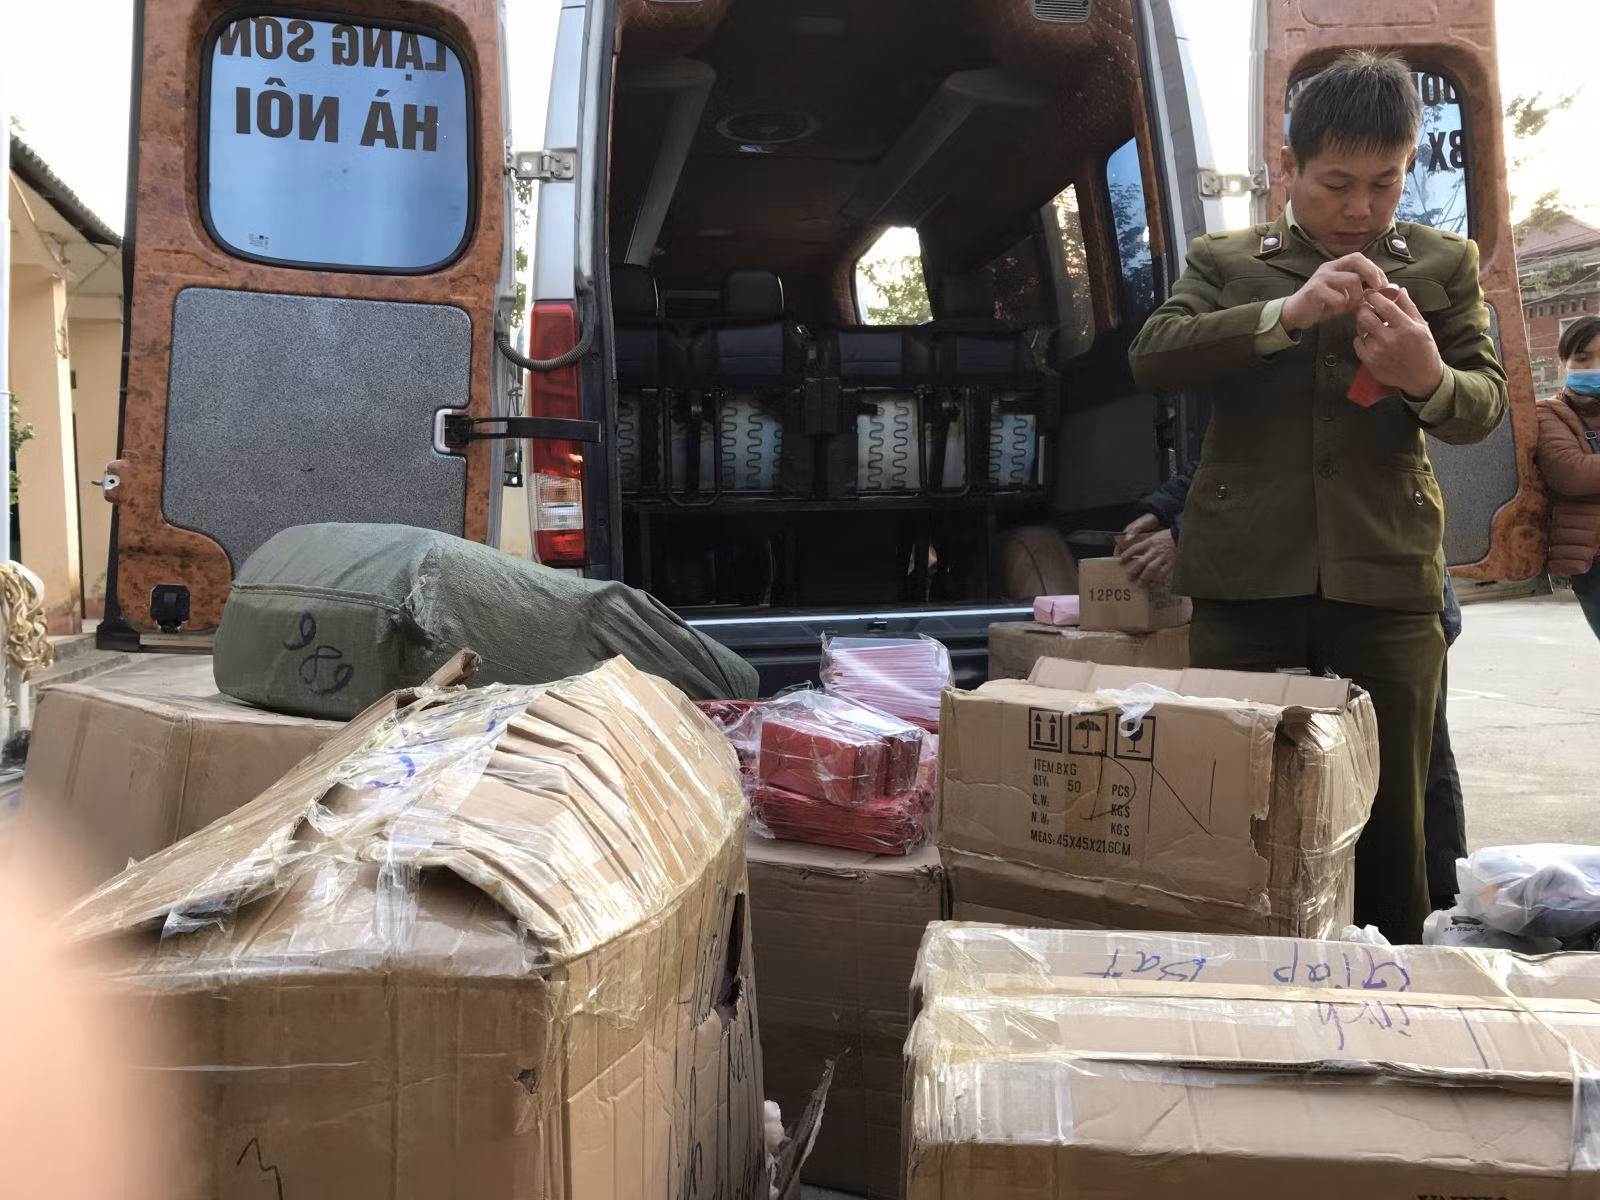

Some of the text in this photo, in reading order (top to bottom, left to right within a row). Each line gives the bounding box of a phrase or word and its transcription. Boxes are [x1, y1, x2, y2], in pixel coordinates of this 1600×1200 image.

[1089, 588, 1132, 602] 12PCS
[1067, 779, 1082, 794] 50
[1111, 784, 1130, 798] PCS
[1111, 803, 1131, 819] KGS
[1110, 822, 1130, 837] KGS
